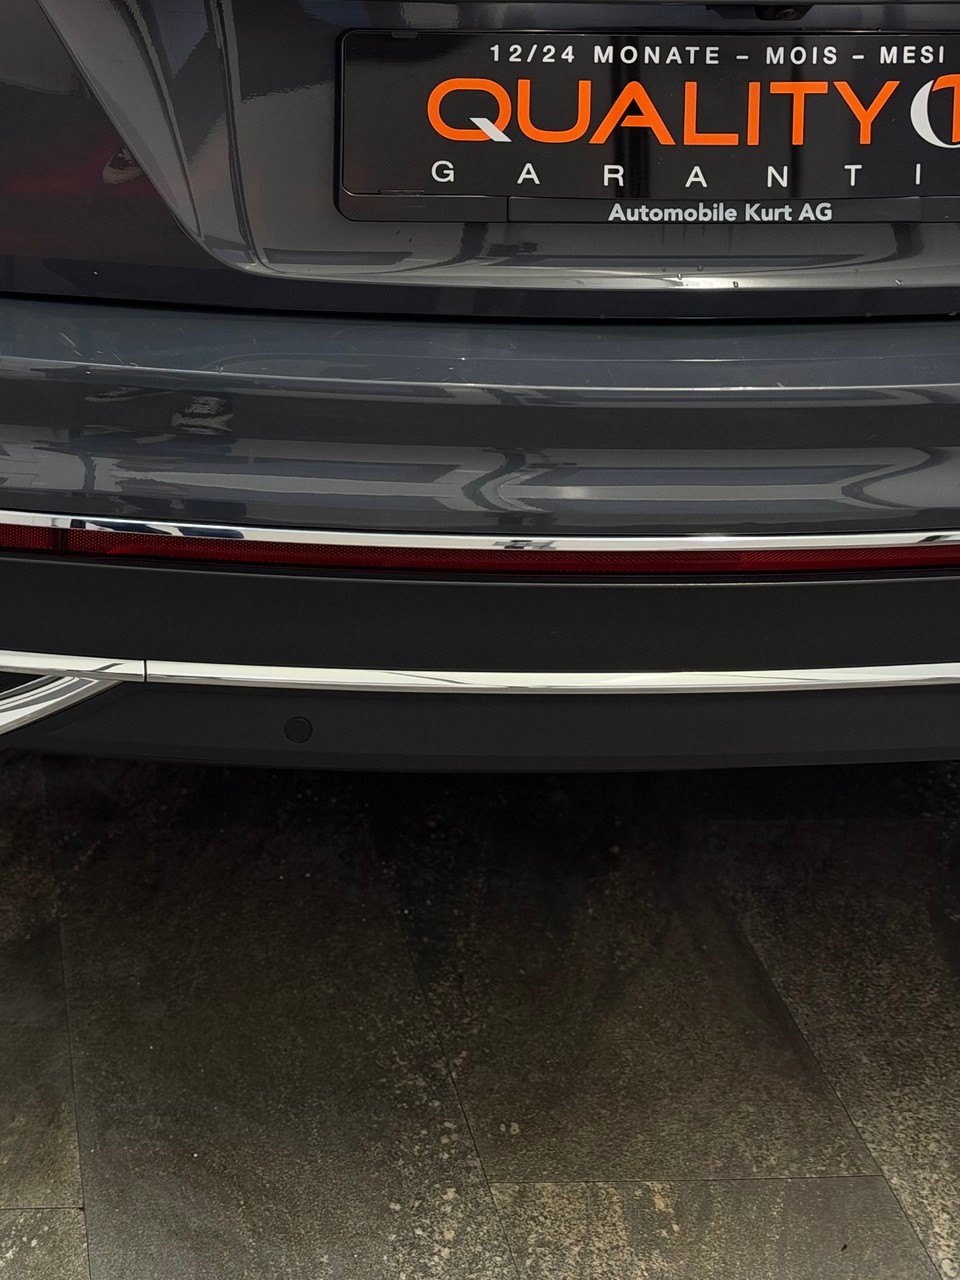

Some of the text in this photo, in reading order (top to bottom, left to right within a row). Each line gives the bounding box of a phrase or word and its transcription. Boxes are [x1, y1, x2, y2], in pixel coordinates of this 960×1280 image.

[490, 44, 576, 64] 12/24
[593, 45, 721, 65] MONATE
[765, 45, 838, 65] MOIS
[880, 45, 945, 64] MESI
[427, 78, 900, 146] QUALITY
[431, 160, 922, 188] GARANTI
[608, 203, 833, 222] Automobile Kurt AG
